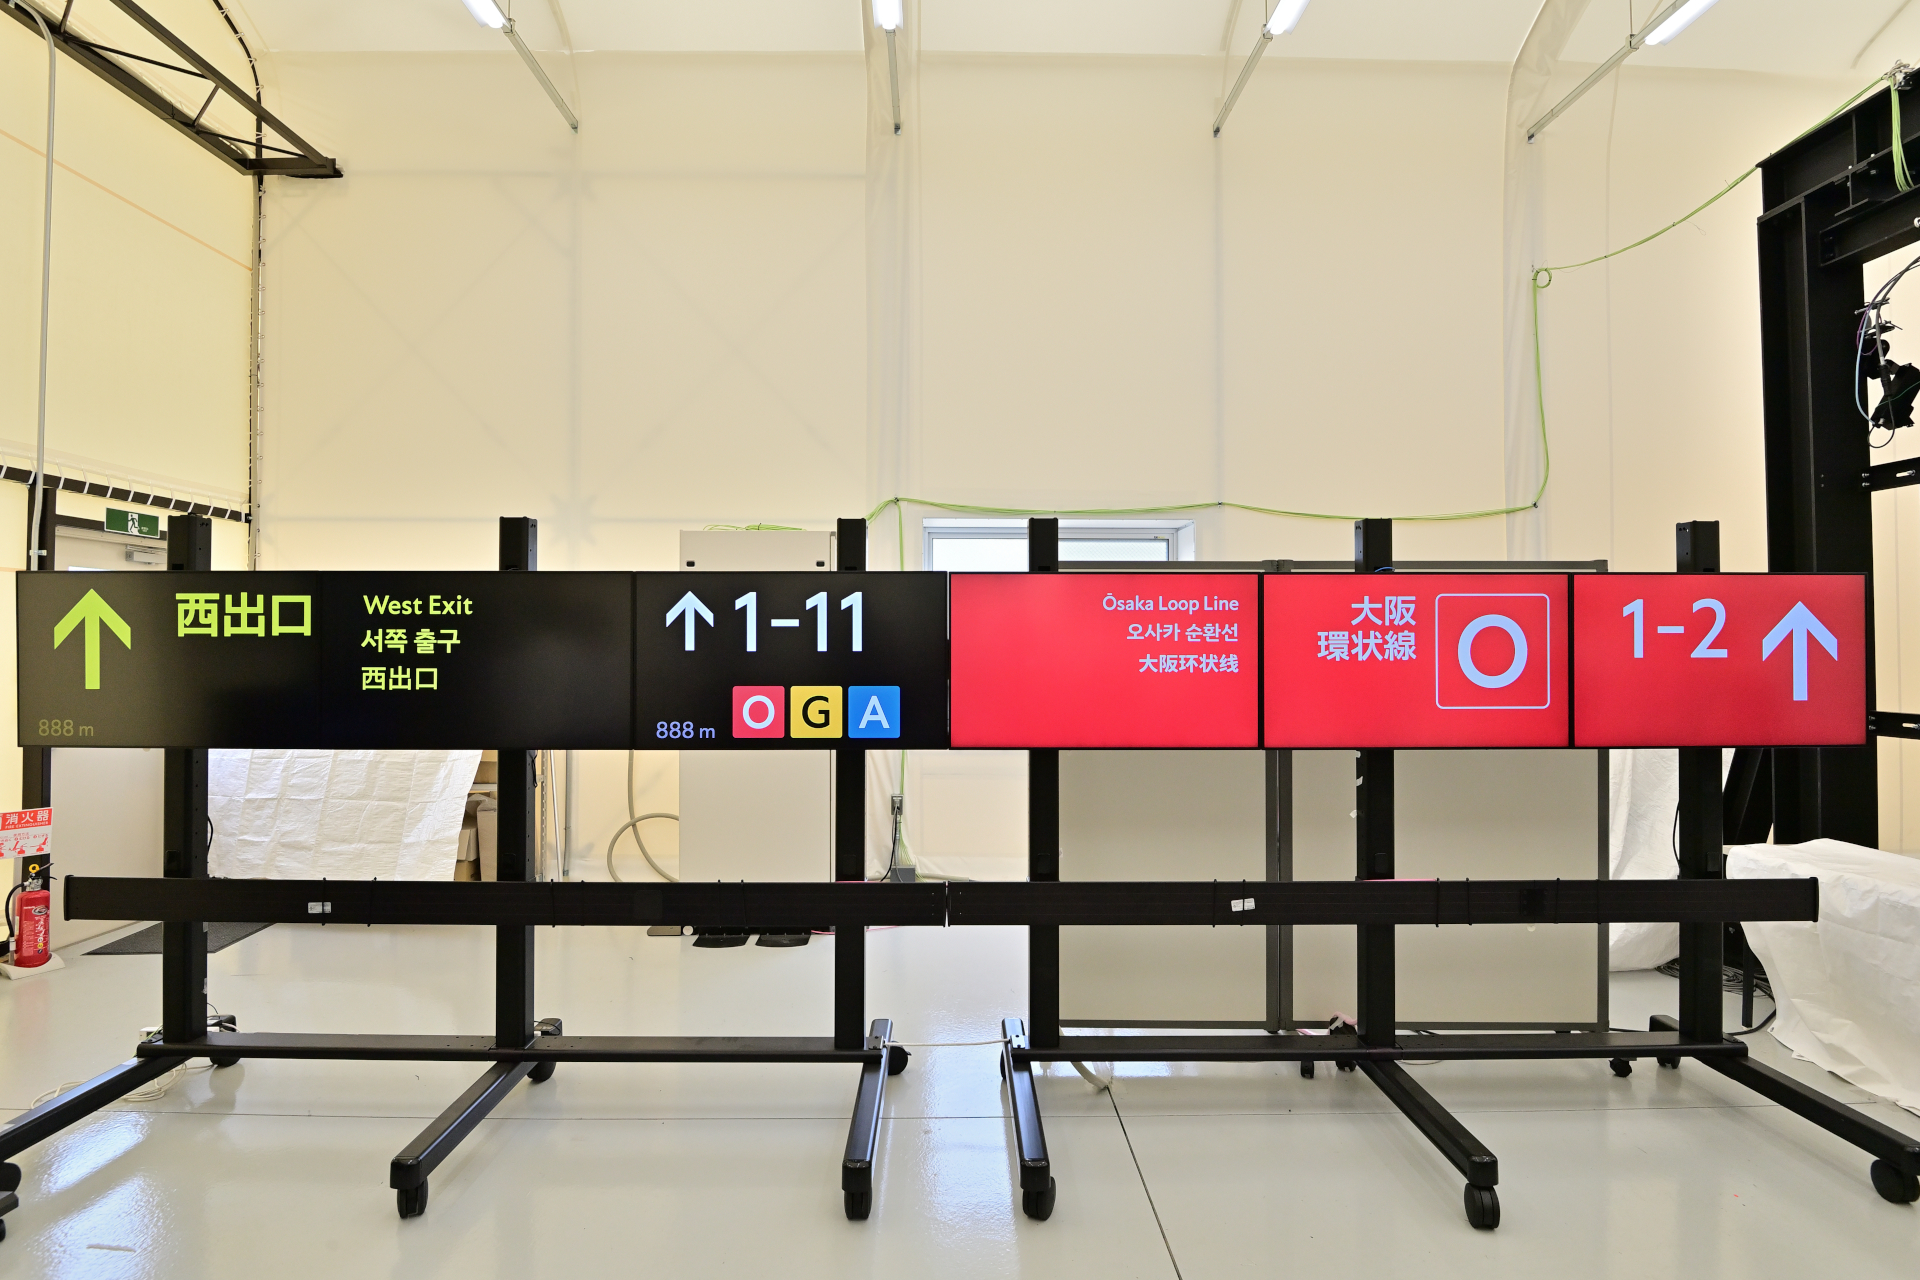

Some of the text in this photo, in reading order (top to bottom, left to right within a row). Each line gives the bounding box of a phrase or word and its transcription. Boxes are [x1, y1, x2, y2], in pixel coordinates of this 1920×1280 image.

[176, 592, 312, 638] 西出口
[363, 594, 473, 615] West Exit
[1102, 592, 1240, 615] Ōsaka Loop Line
[1351, 595, 1417, 627] 大阪
[361, 628, 461, 654] 서쪽 출구
[1126, 622, 1239, 643] 오사카 순환선
[1316, 629, 1417, 662] 環状線
[1138, 653, 1239, 674] 大阪环状线
[1457, 613, 1529, 689] O
[361, 665, 438, 691] 西出口
[742, 695, 775, 730] O
[801, 695, 830, 729] G
[858, 695, 891, 729] A
[38, 719, 94, 737] 888 m
[656, 720, 716, 739] 888 m
[5, 809, 49, 825] 消火器
